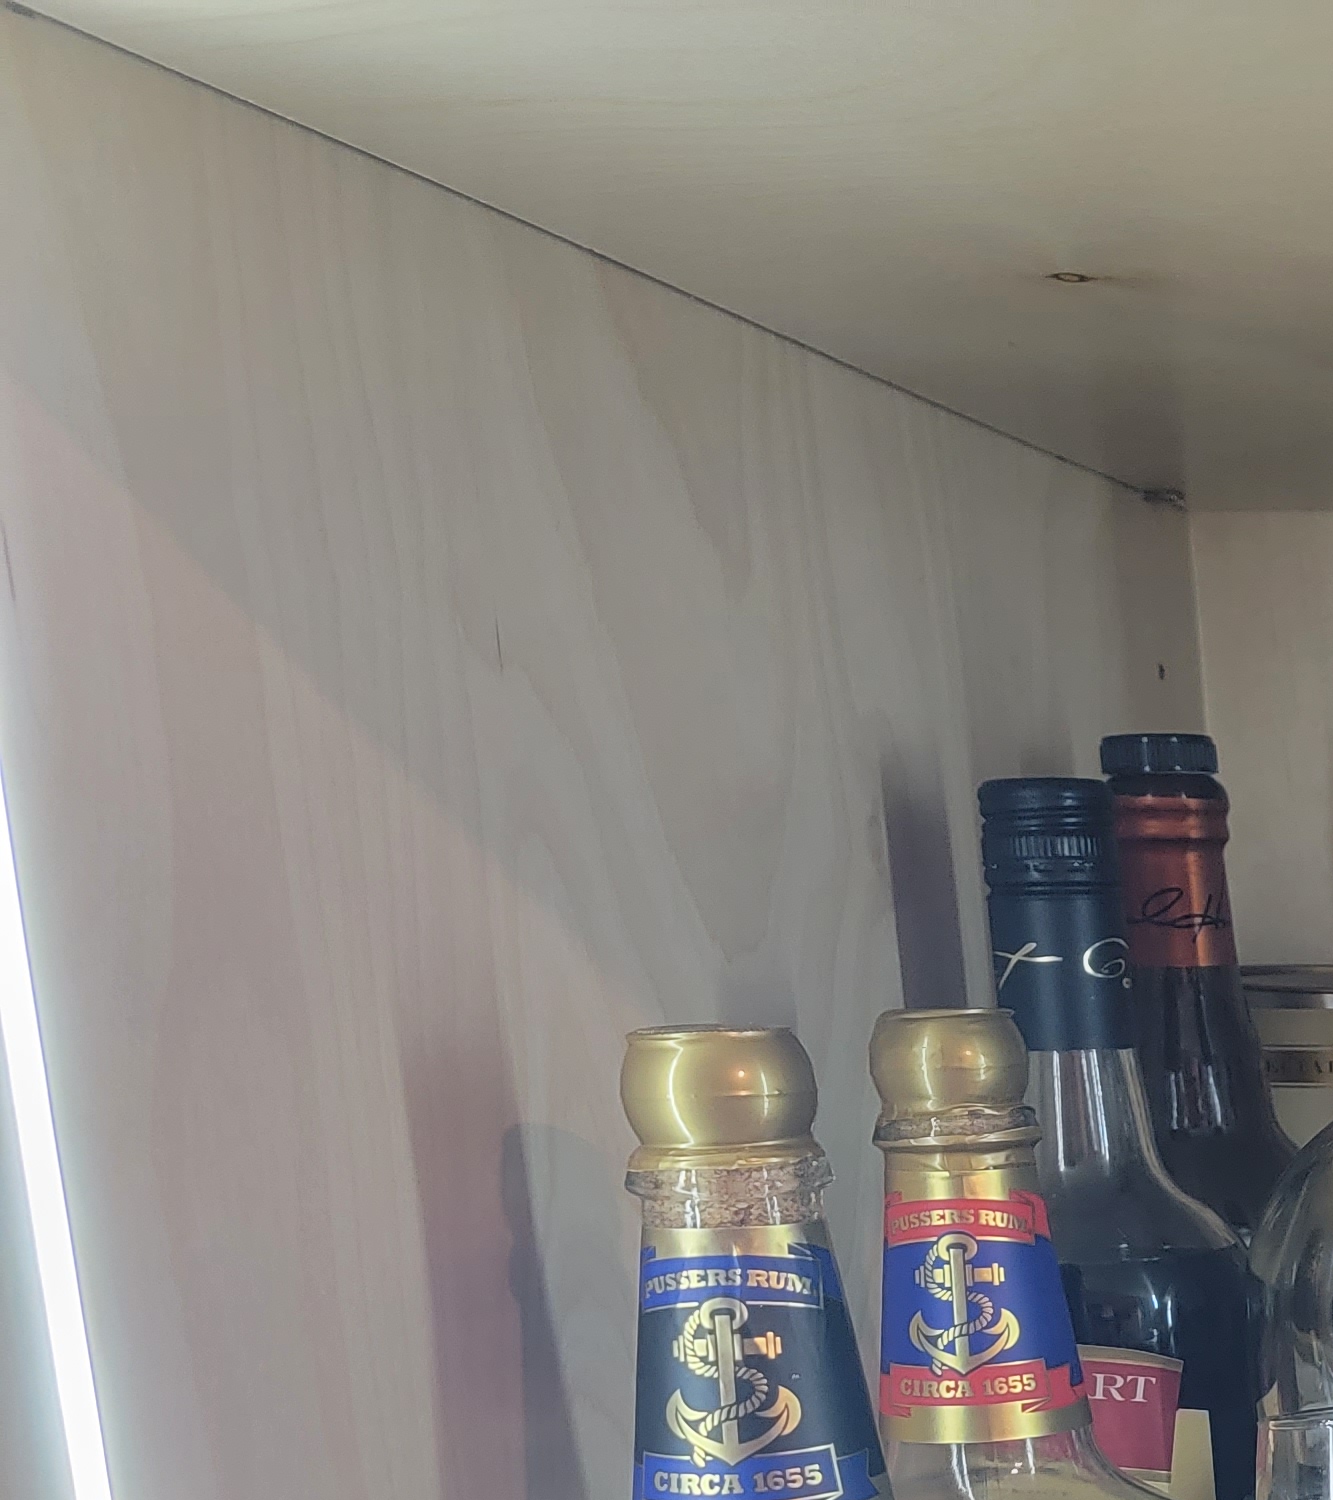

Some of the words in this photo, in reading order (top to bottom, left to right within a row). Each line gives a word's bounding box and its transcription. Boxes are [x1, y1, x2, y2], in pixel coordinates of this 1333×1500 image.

[891, 1209, 974, 1235] PUSSERS
[644, 1268, 743, 1299] PUSSERS
[900, 1376, 972, 1398] CIRCA
[983, 1373, 1037, 1395] 1655
[654, 1470, 744, 1496] CIRCA
[753, 1464, 823, 1493] 1655
